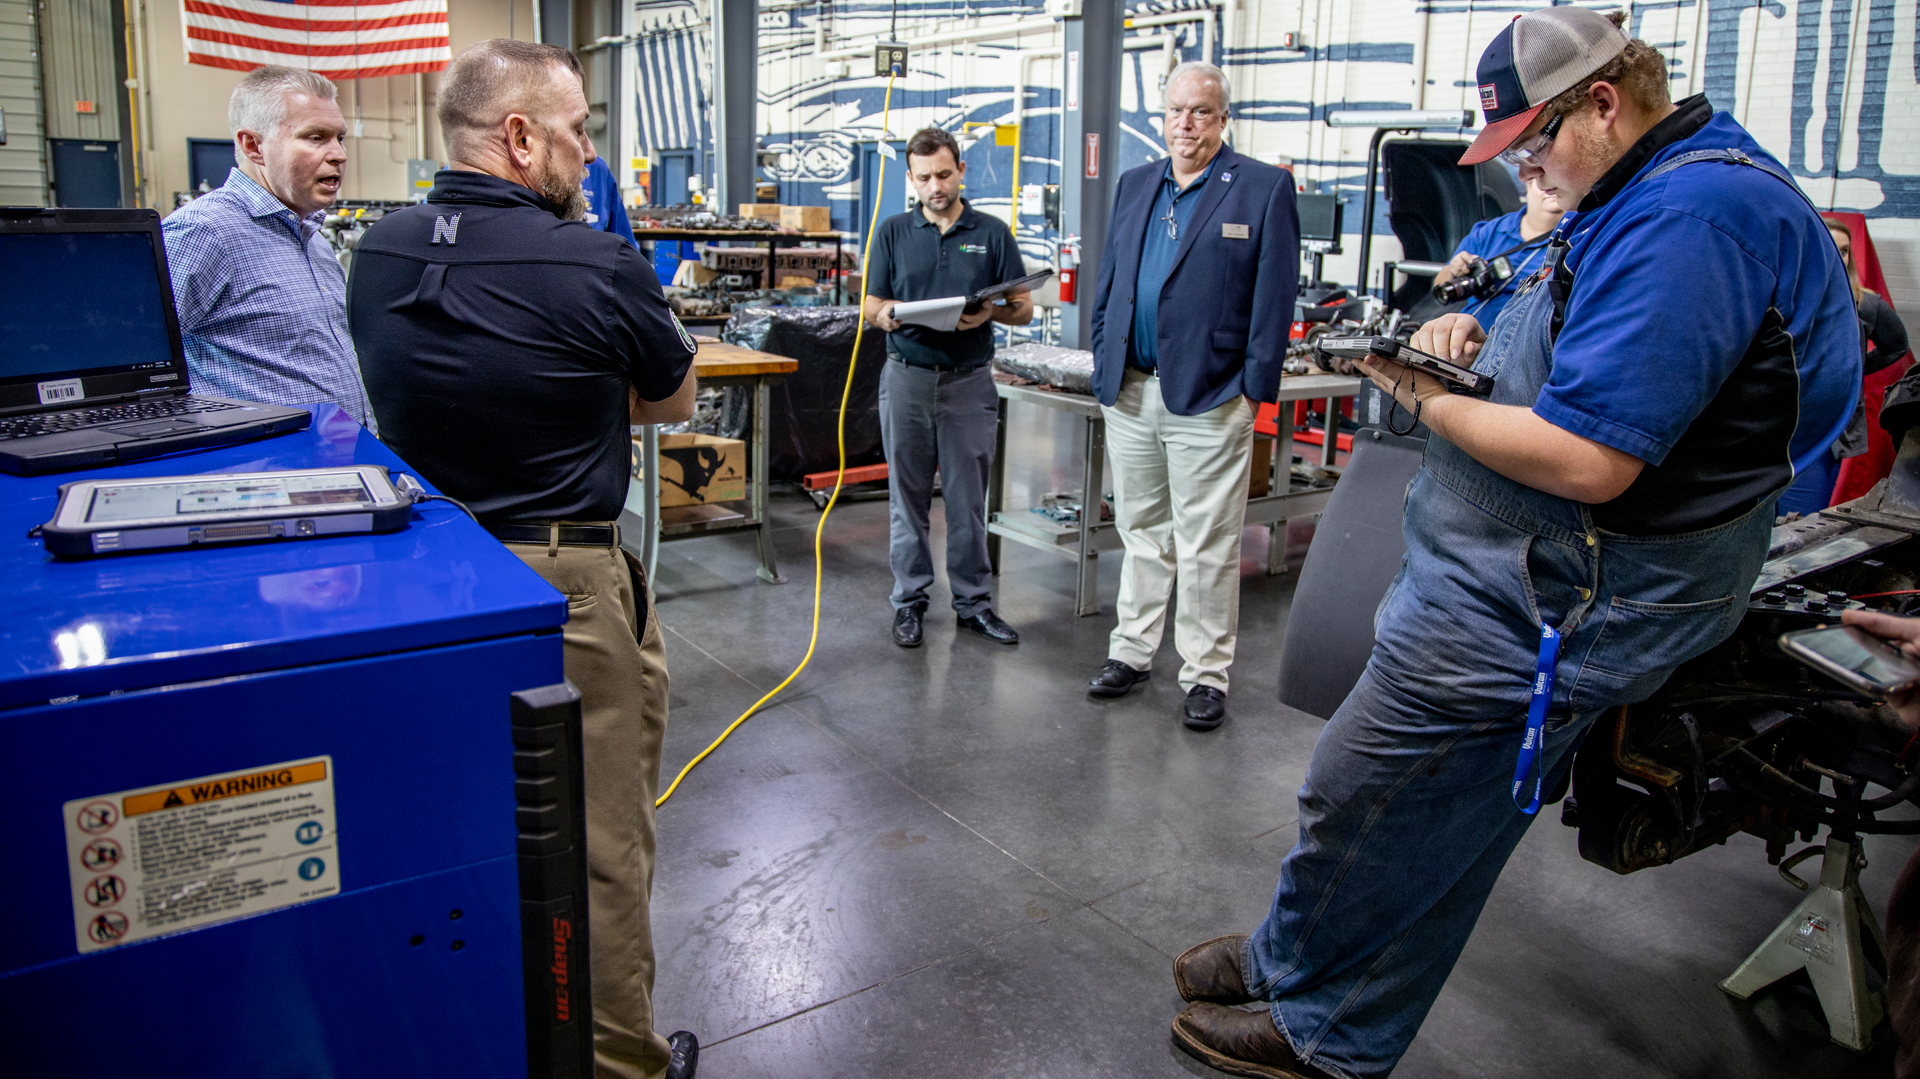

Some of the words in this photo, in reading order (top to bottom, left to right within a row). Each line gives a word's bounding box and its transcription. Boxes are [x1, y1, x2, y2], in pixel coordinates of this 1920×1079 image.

[432, 212, 462, 244] N
[1534, 672, 1546, 695] Vulcan
[1522, 727, 1536, 749] Vulcan
[191, 771, 292, 799] WARNING
[551, 917, 571, 1021] Snap-on
